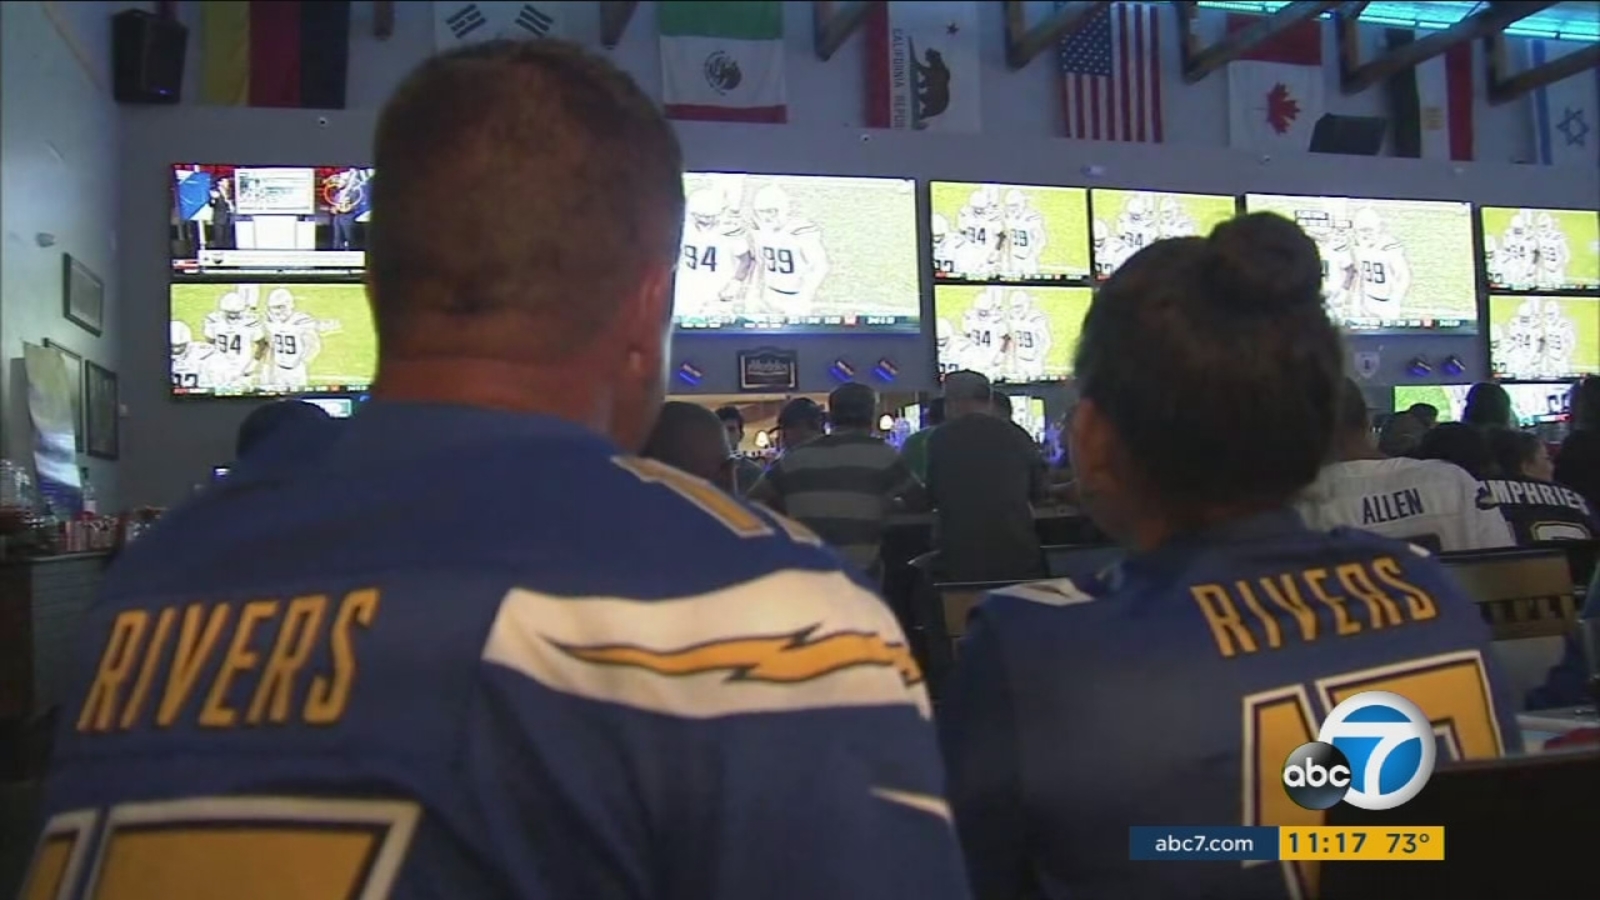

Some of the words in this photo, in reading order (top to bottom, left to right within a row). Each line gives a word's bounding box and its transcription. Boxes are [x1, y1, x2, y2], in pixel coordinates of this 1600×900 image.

[1363, 487, 1425, 525] ALLEN
[1189, 555, 1438, 658] RIVERS
[75, 587, 381, 732] RIVERS
